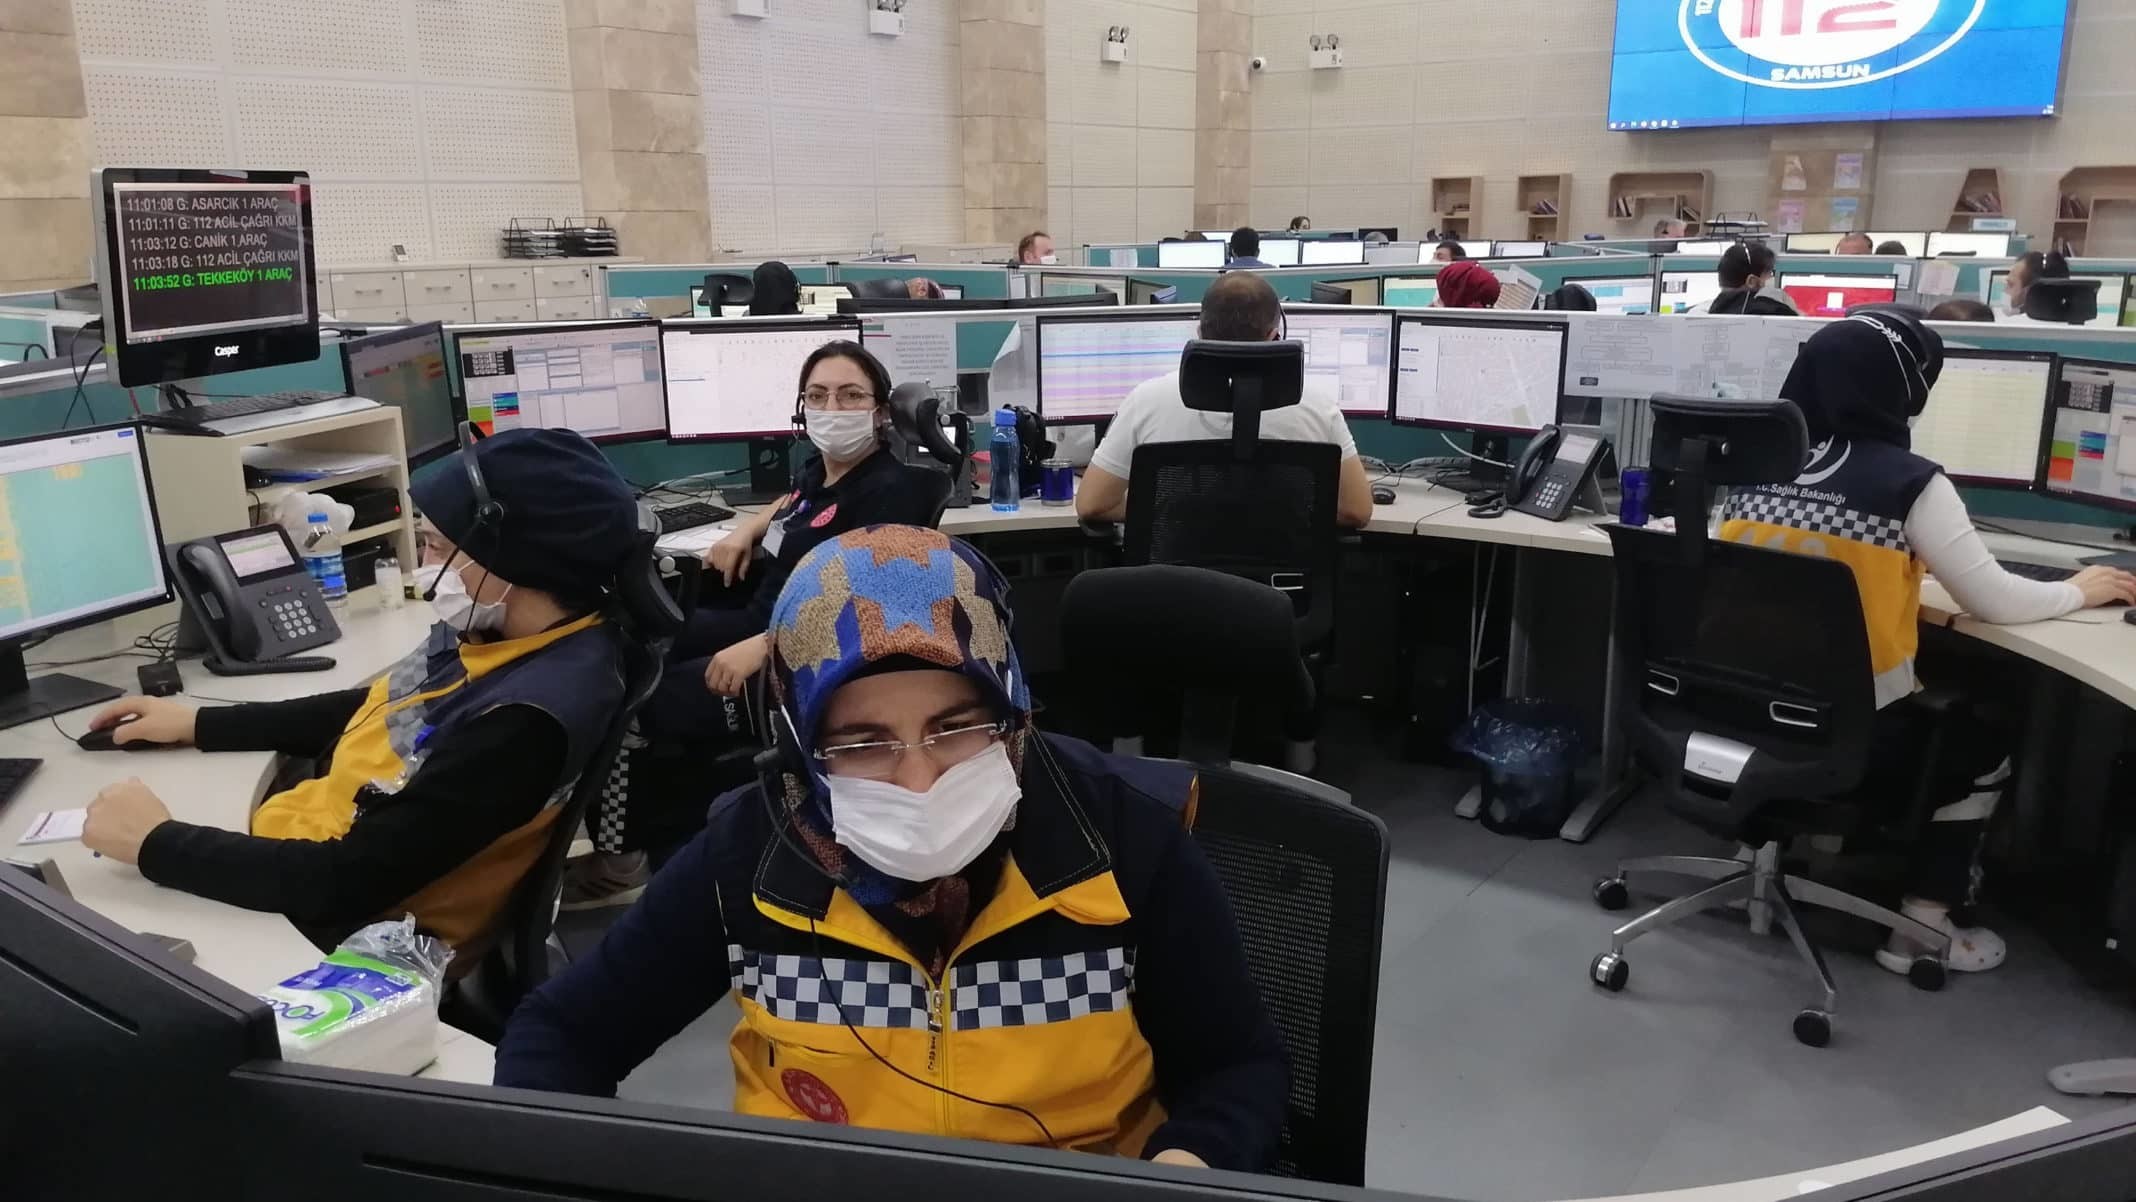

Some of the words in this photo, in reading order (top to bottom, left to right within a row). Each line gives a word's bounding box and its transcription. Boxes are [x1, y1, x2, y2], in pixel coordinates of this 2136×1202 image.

[1770, 63, 1870, 81] SAMSUN
[127, 197, 174, 211] 11:01:08
[243, 197, 248, 209] 1
[250, 197, 279, 212] ARAÇ
[128, 217, 175, 231] 11:01:11
[178, 216, 191, 229] G:
[194, 216, 212, 229] 112
[214, 213, 239, 229] ACİL
[240, 213, 273, 231] ÇAĞRI
[275, 214, 297, 226] KKM
[130, 236, 177, 251] 11:03:12
[180, 236, 192, 248] G:
[194, 232, 228, 248] CANİK
[231, 235, 236, 246] 1
[240, 233, 268, 248] ARAÇ
[132, 255, 178, 270] 11:03:18
[181, 255, 193, 268] G:
[196, 254, 215, 267] 112
[217, 250, 241, 265] ACİL
[243, 249, 275, 267] ÇAĞRI
[278, 249, 299, 261] KKM
[133, 274, 180, 290] 11:03:52
[182, 273, 195, 286] G:
[196, 267, 254, 285] TEKKEKÖY
[257, 269, 262, 280] 1
[265, 267, 293, 281] ARAÇ
[1800, 487, 1847, 506] Bakanlığı
